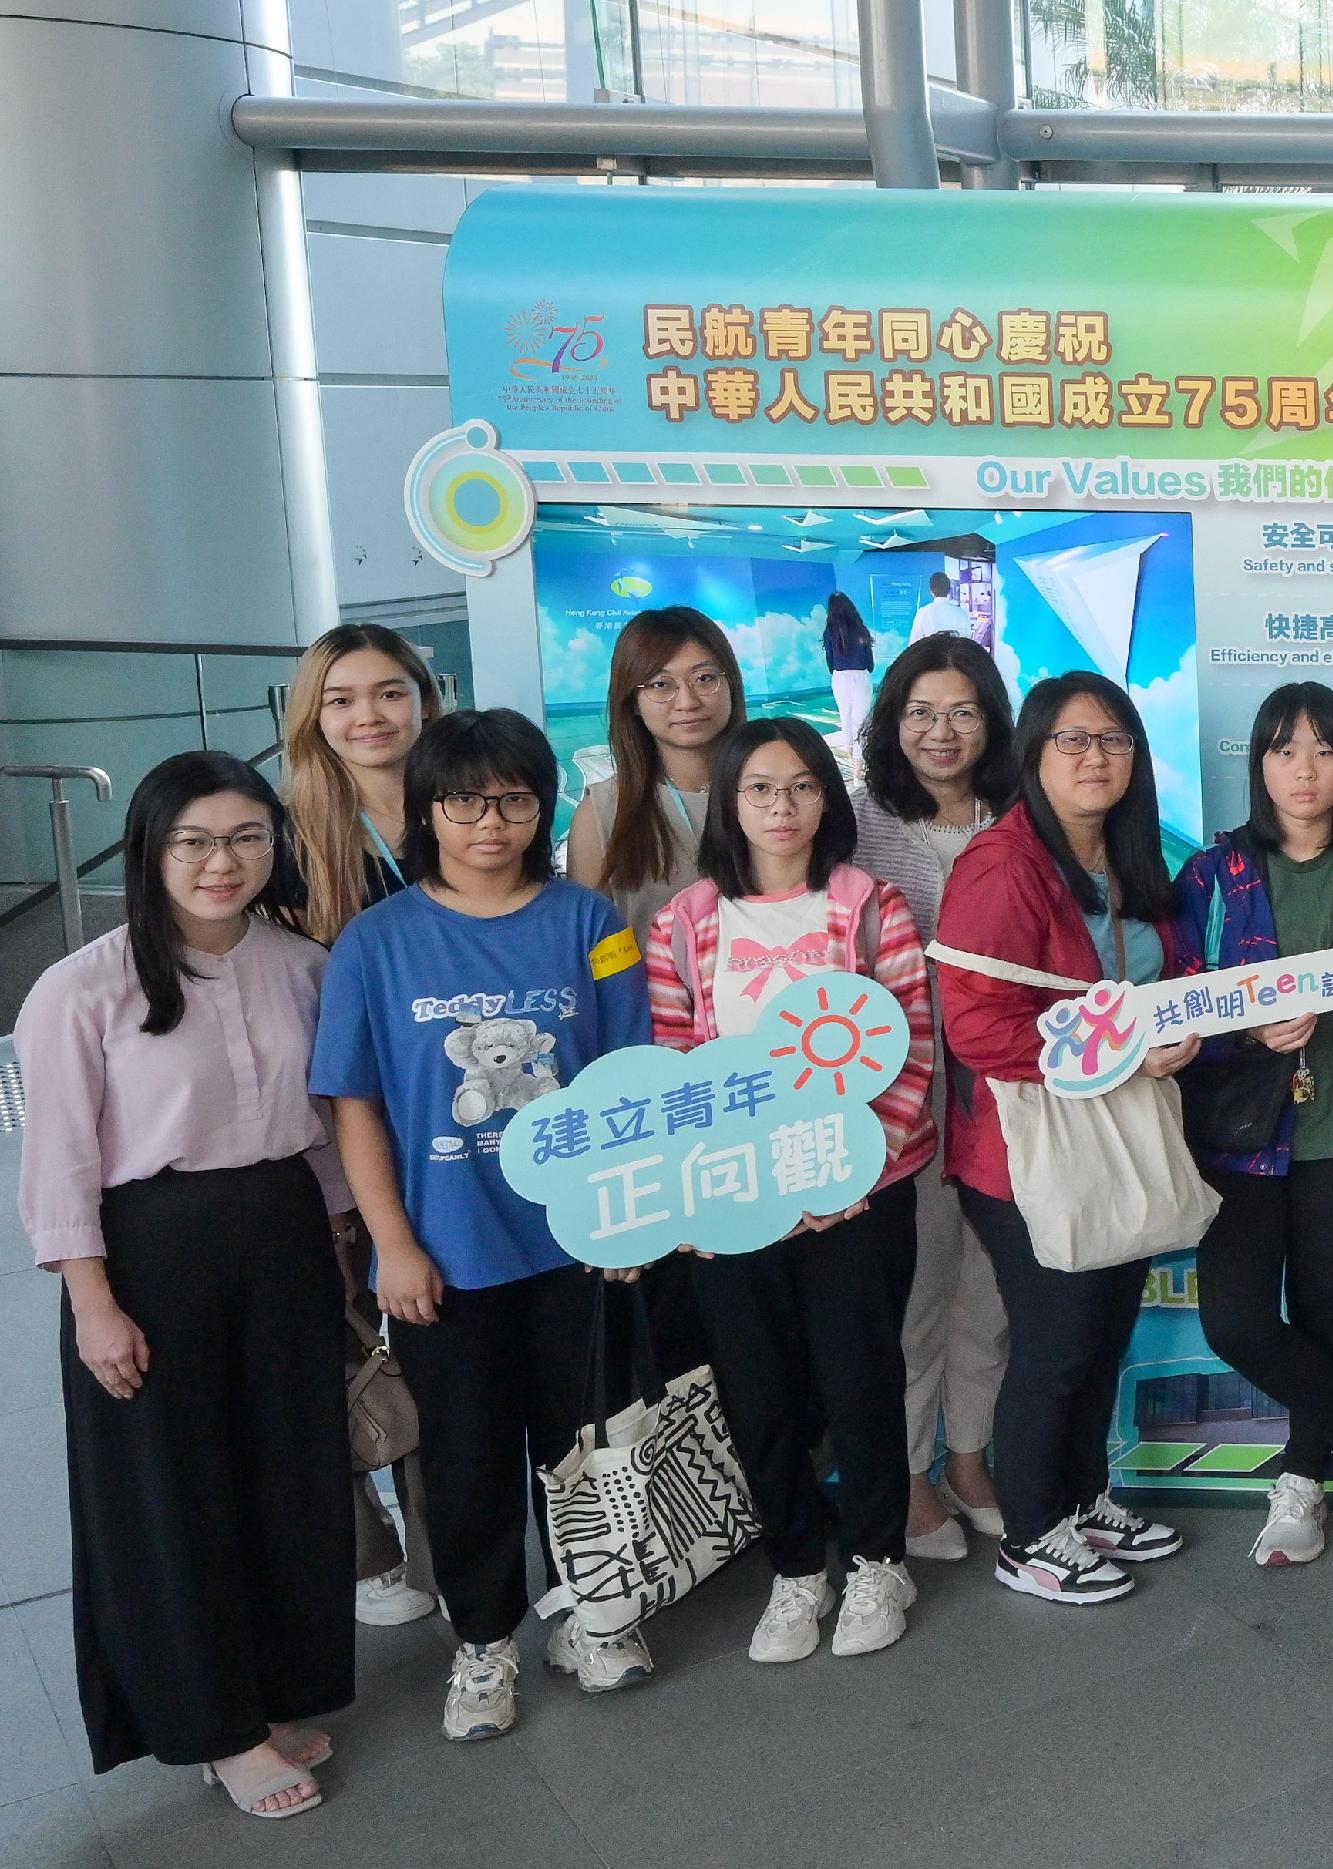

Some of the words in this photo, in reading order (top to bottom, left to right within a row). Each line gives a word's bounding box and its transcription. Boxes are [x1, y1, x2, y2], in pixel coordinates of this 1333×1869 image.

[549, 313, 605, 373] 75
[643, 304, 1112, 366] 民航青年同心慶祝
[976, 460, 1053, 496] Our
[1062, 461, 1208, 498] Values
[1243, 558, 1294, 575] Safety
[1297, 559, 1325, 573] and
[1210, 649, 1289, 666] Efficiency
[1291, 650, 1319, 664] and
[530, 1070, 776, 1166] 建立青年
[586, 1112, 854, 1241] 正向觀
